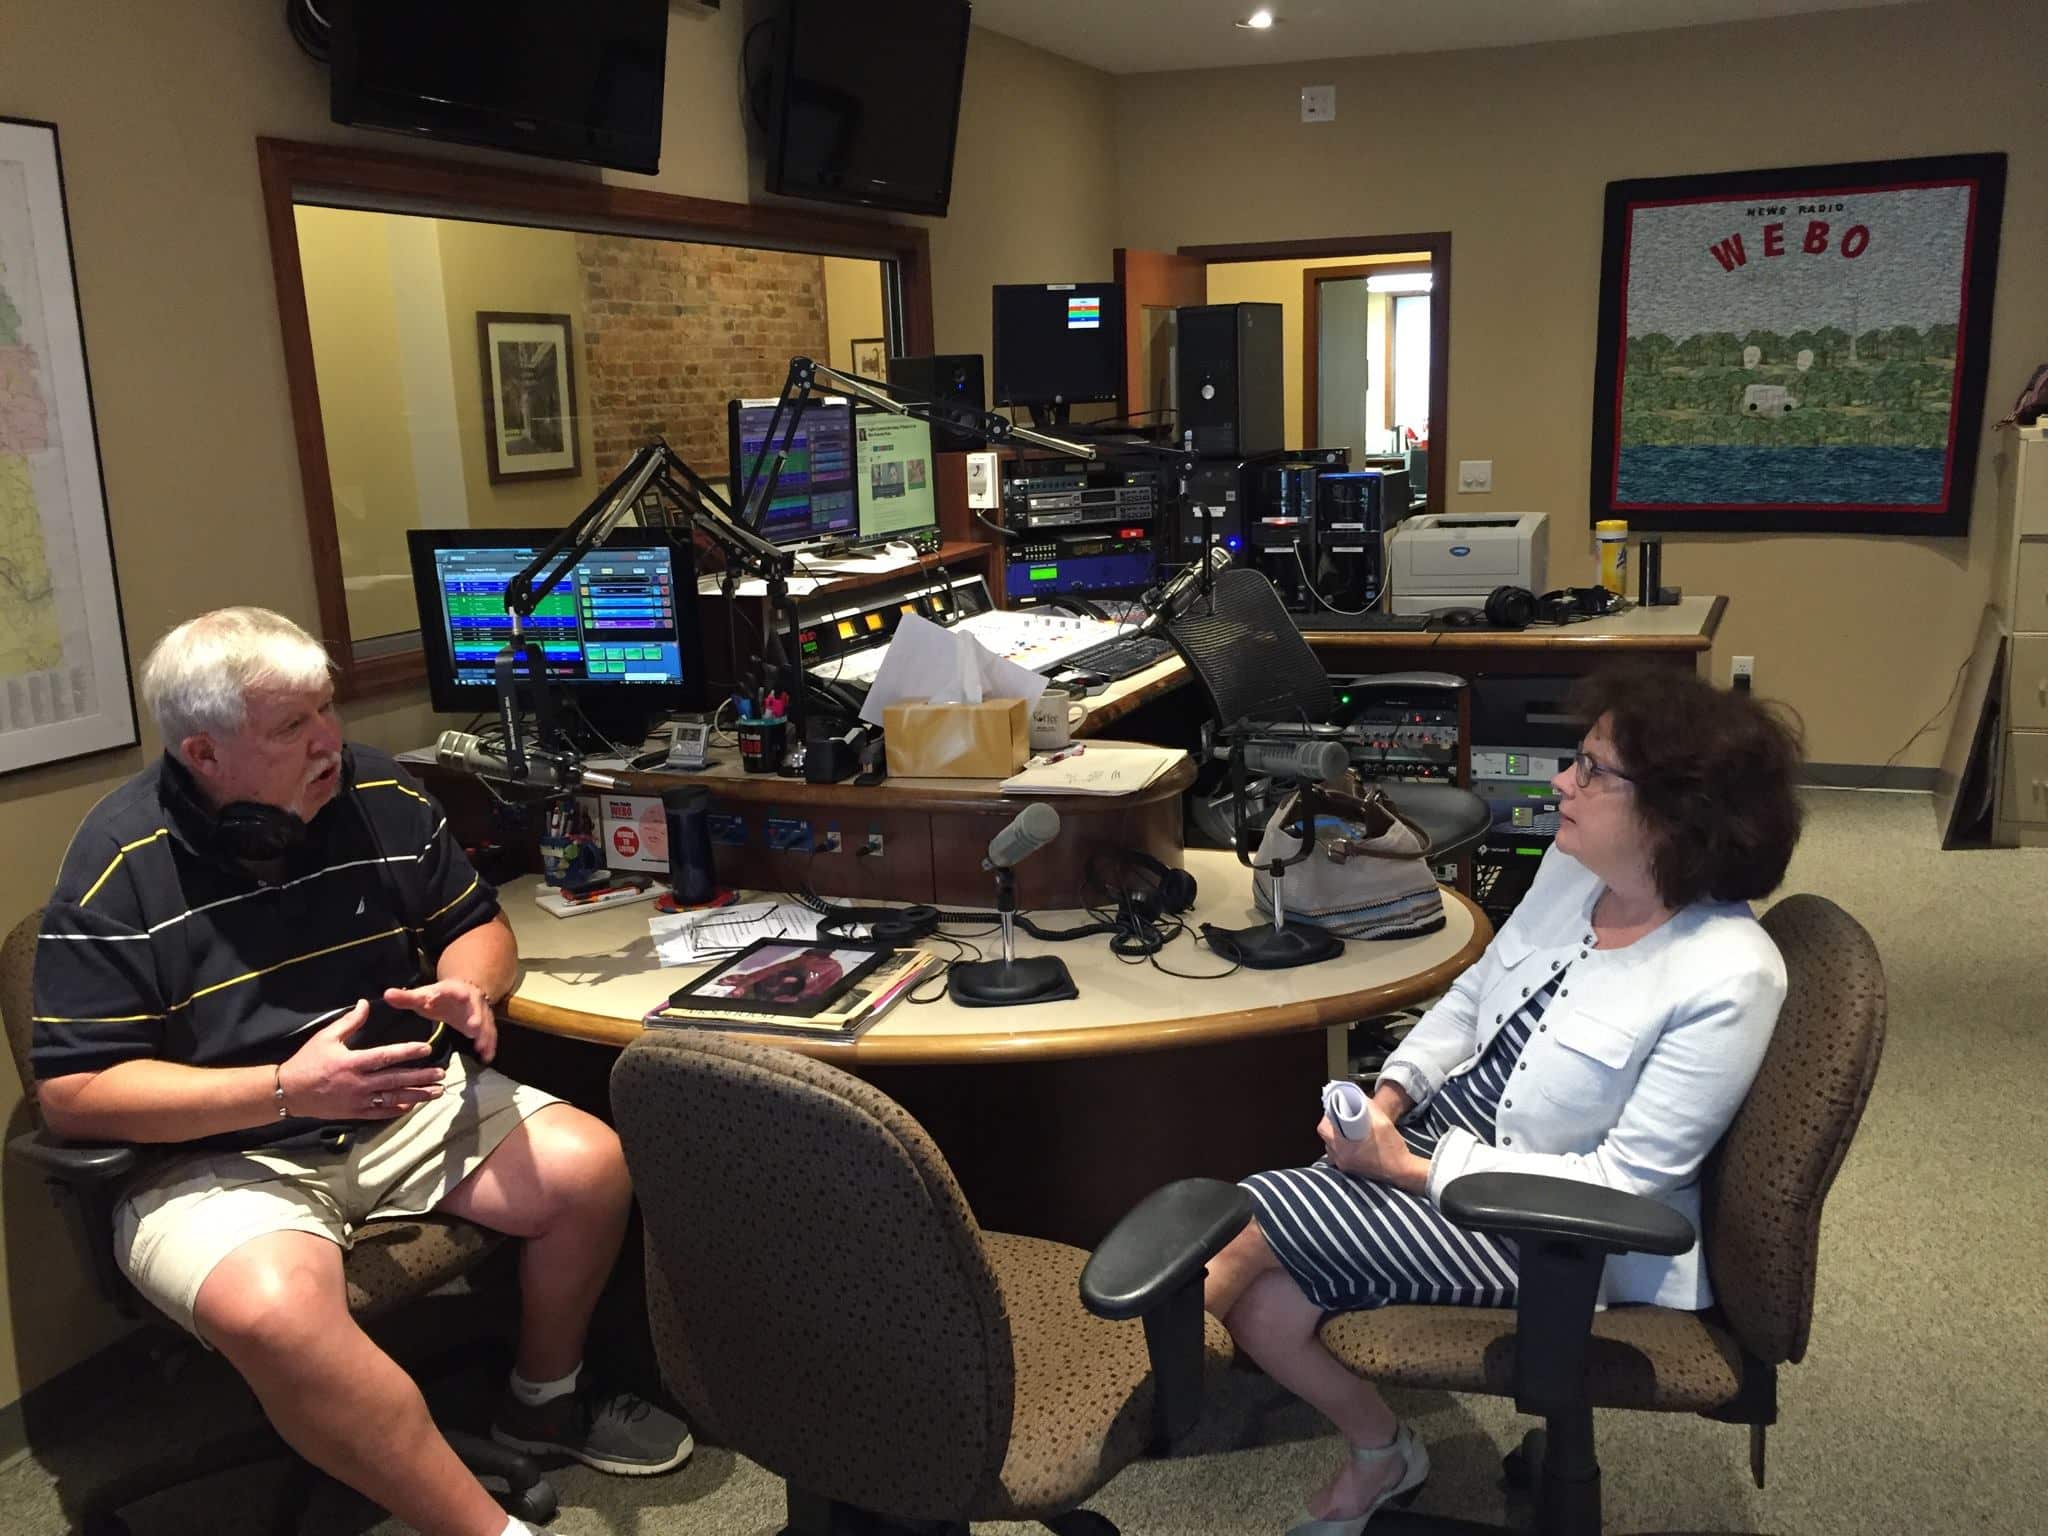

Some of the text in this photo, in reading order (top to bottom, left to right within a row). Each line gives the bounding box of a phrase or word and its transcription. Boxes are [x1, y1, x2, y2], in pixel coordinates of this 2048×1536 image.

[1746, 203, 1845, 217] NEWS RADIO
[1709, 219, 1871, 273] WEBO
